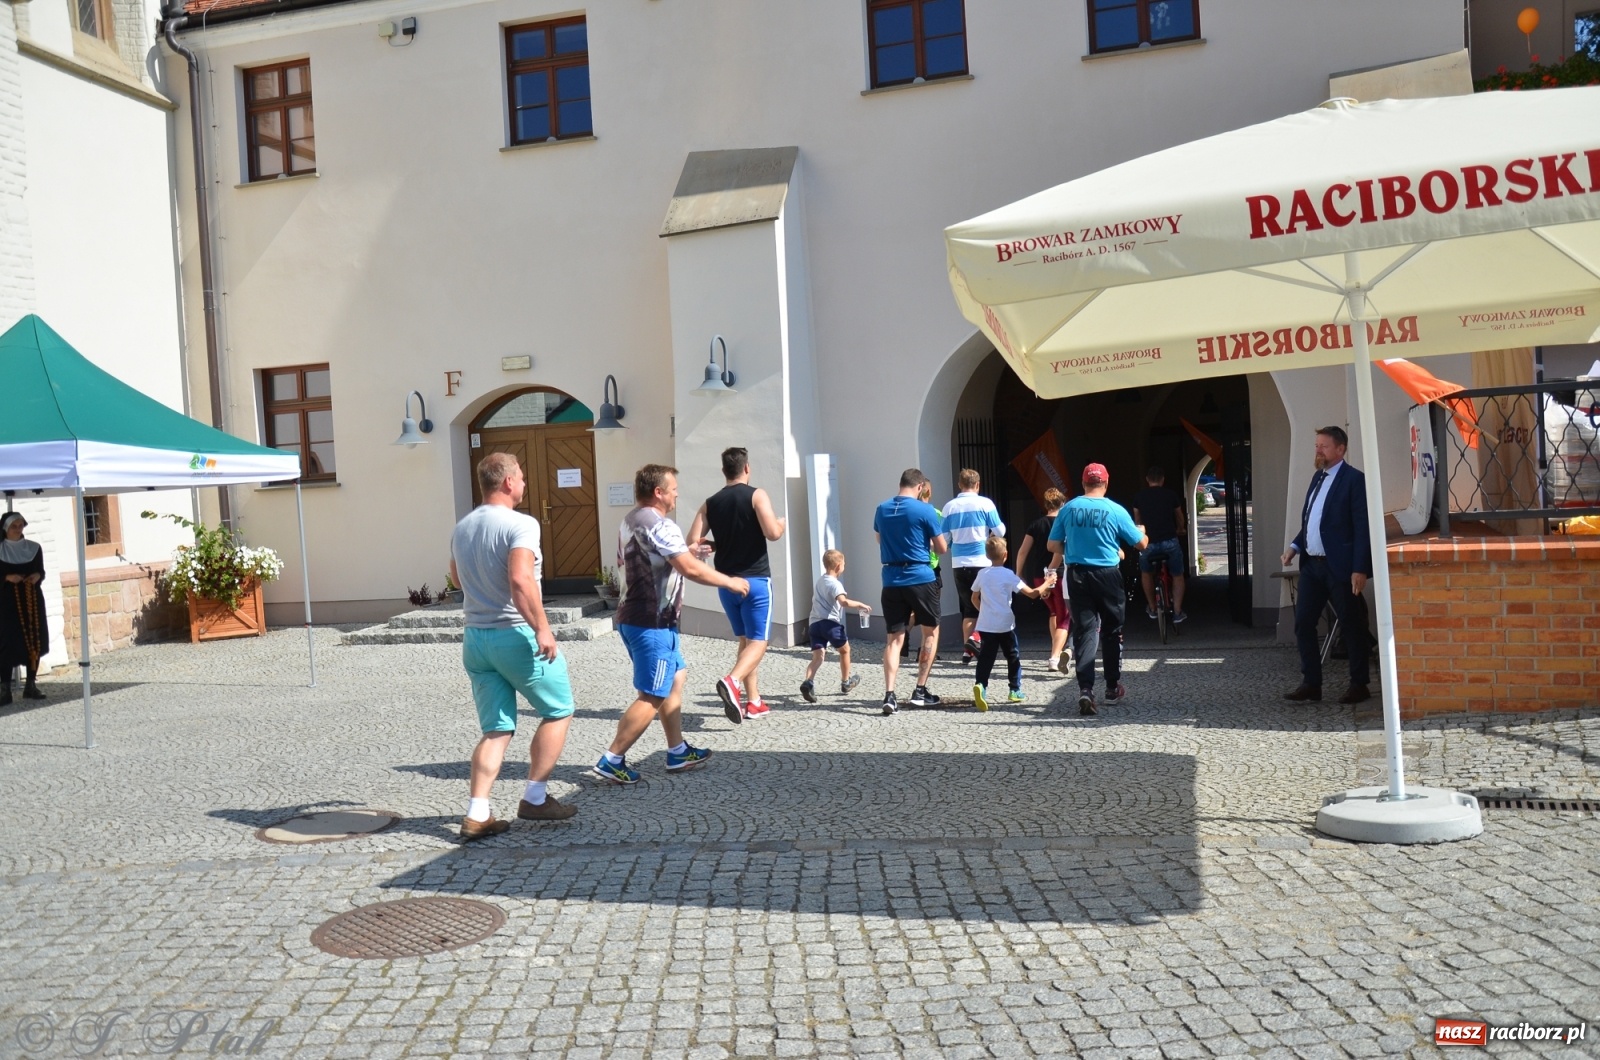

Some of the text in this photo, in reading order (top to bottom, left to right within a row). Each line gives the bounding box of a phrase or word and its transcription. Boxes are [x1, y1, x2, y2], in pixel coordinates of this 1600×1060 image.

[995, 214, 1183, 263] BROWAR ZAMKOWY
[1042, 240, 1137, 264] Racibórz A. D. 1567
[443, 370, 462, 397] F
[1070, 507, 1110, 529] TOMEK
